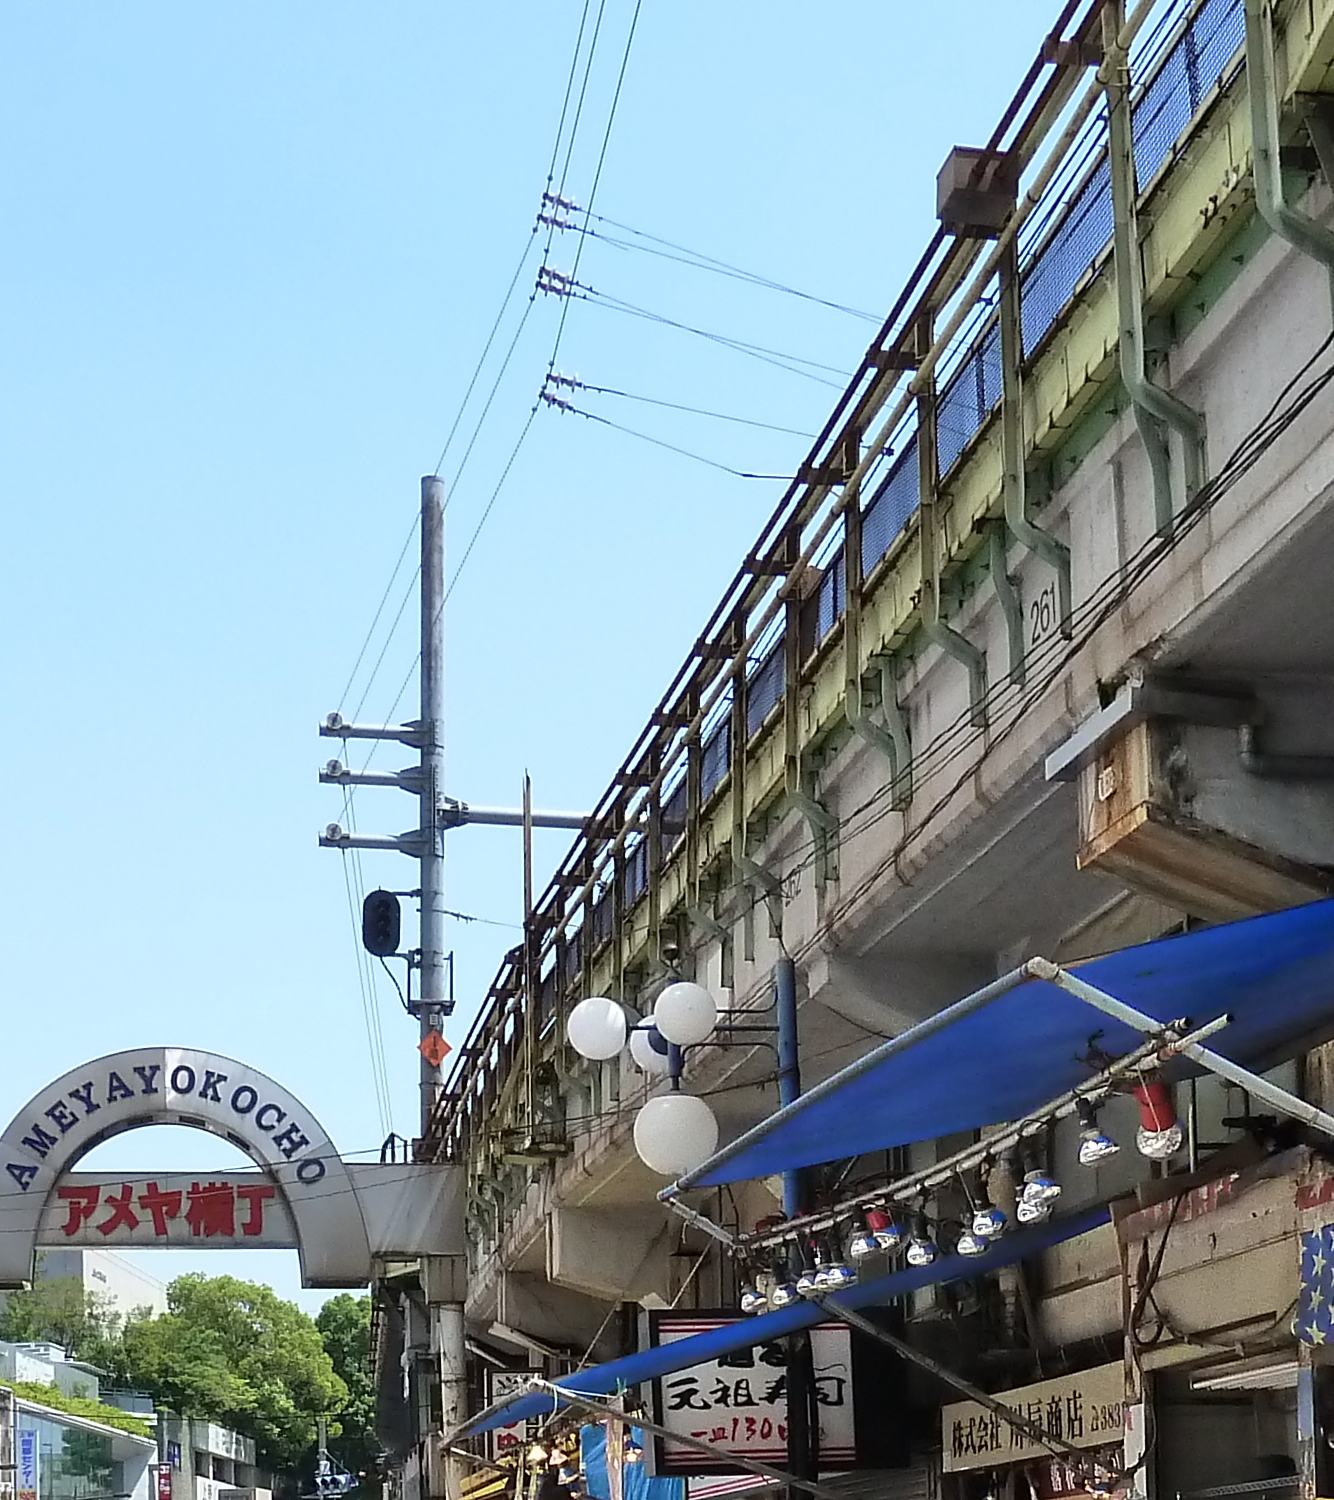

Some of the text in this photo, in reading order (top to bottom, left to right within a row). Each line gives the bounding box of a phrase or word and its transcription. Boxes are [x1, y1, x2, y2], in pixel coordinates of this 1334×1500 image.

[1030, 581, 1056, 645] 261
[5, 1064, 326, 1191] AMEYAYOKOCHO
[57, 1181, 275, 1237] アメヤ横丁
[952, 1414, 1002, 1458] 株式会社
